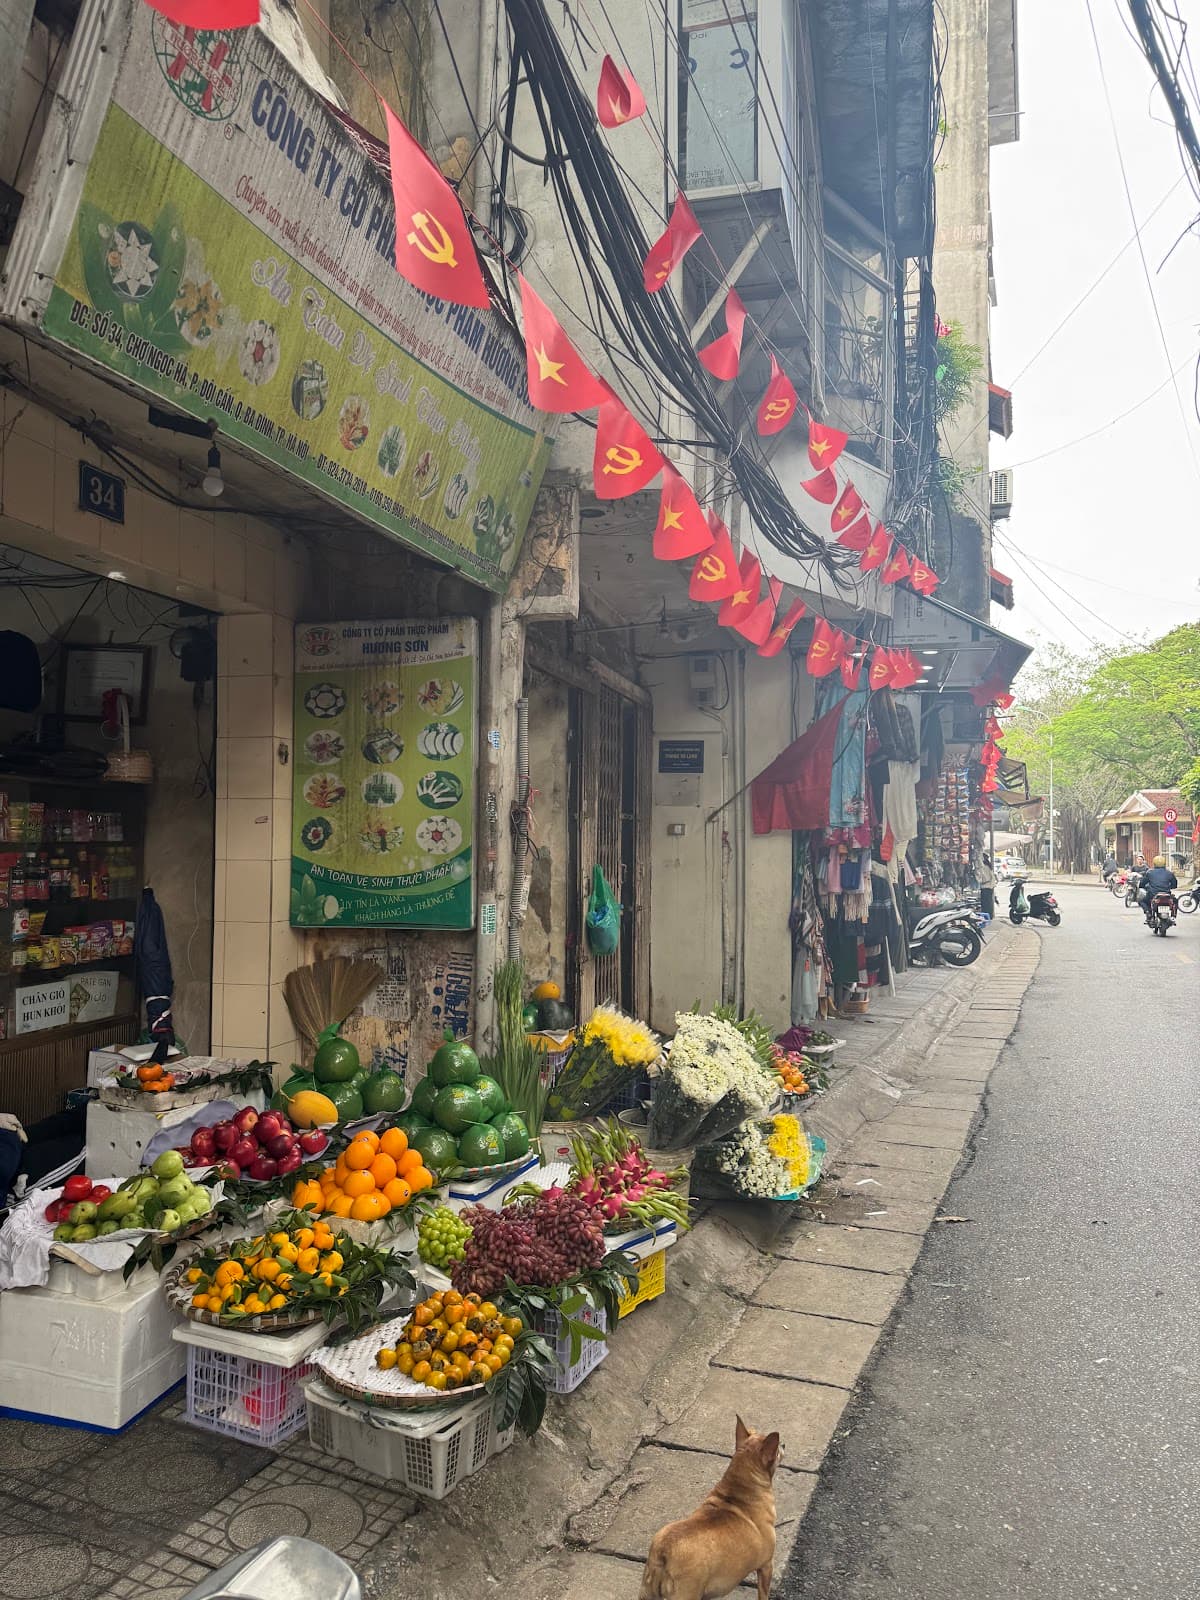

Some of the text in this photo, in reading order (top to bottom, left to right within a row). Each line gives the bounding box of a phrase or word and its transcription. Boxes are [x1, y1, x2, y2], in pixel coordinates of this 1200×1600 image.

[251, 78, 316, 175] CÔNG
[314, 146, 344, 200] TY
[364, 205, 397, 270] PH
[235, 174, 269, 215] Chuyên
[266, 202, 283, 227] sản
[91, 309, 113, 339] SỐ
[107, 322, 126, 352] 34,
[125, 332, 150, 366] CHỢ
[146, 346, 175, 378] NGỌC
[199, 379, 218, 407] ĐỘI
[242, 405, 257, 428] BA
[285, 432, 299, 454] HÀ
[295, 440, 311, 464] NỘI
[89, 476, 115, 511] 34
[342, 627, 361, 639] CÔNG
[363, 627, 372, 637] TY
[362, 639, 429, 655] HƯƠNG SƠN
[310, 864, 325, 878] AN
[371, 877, 394, 888] SINH
[369, 896, 381, 908] LÀ
[22, 987, 65, 1006] CHÂN GIÒ
[23, 1009, 42, 1023] HUN
